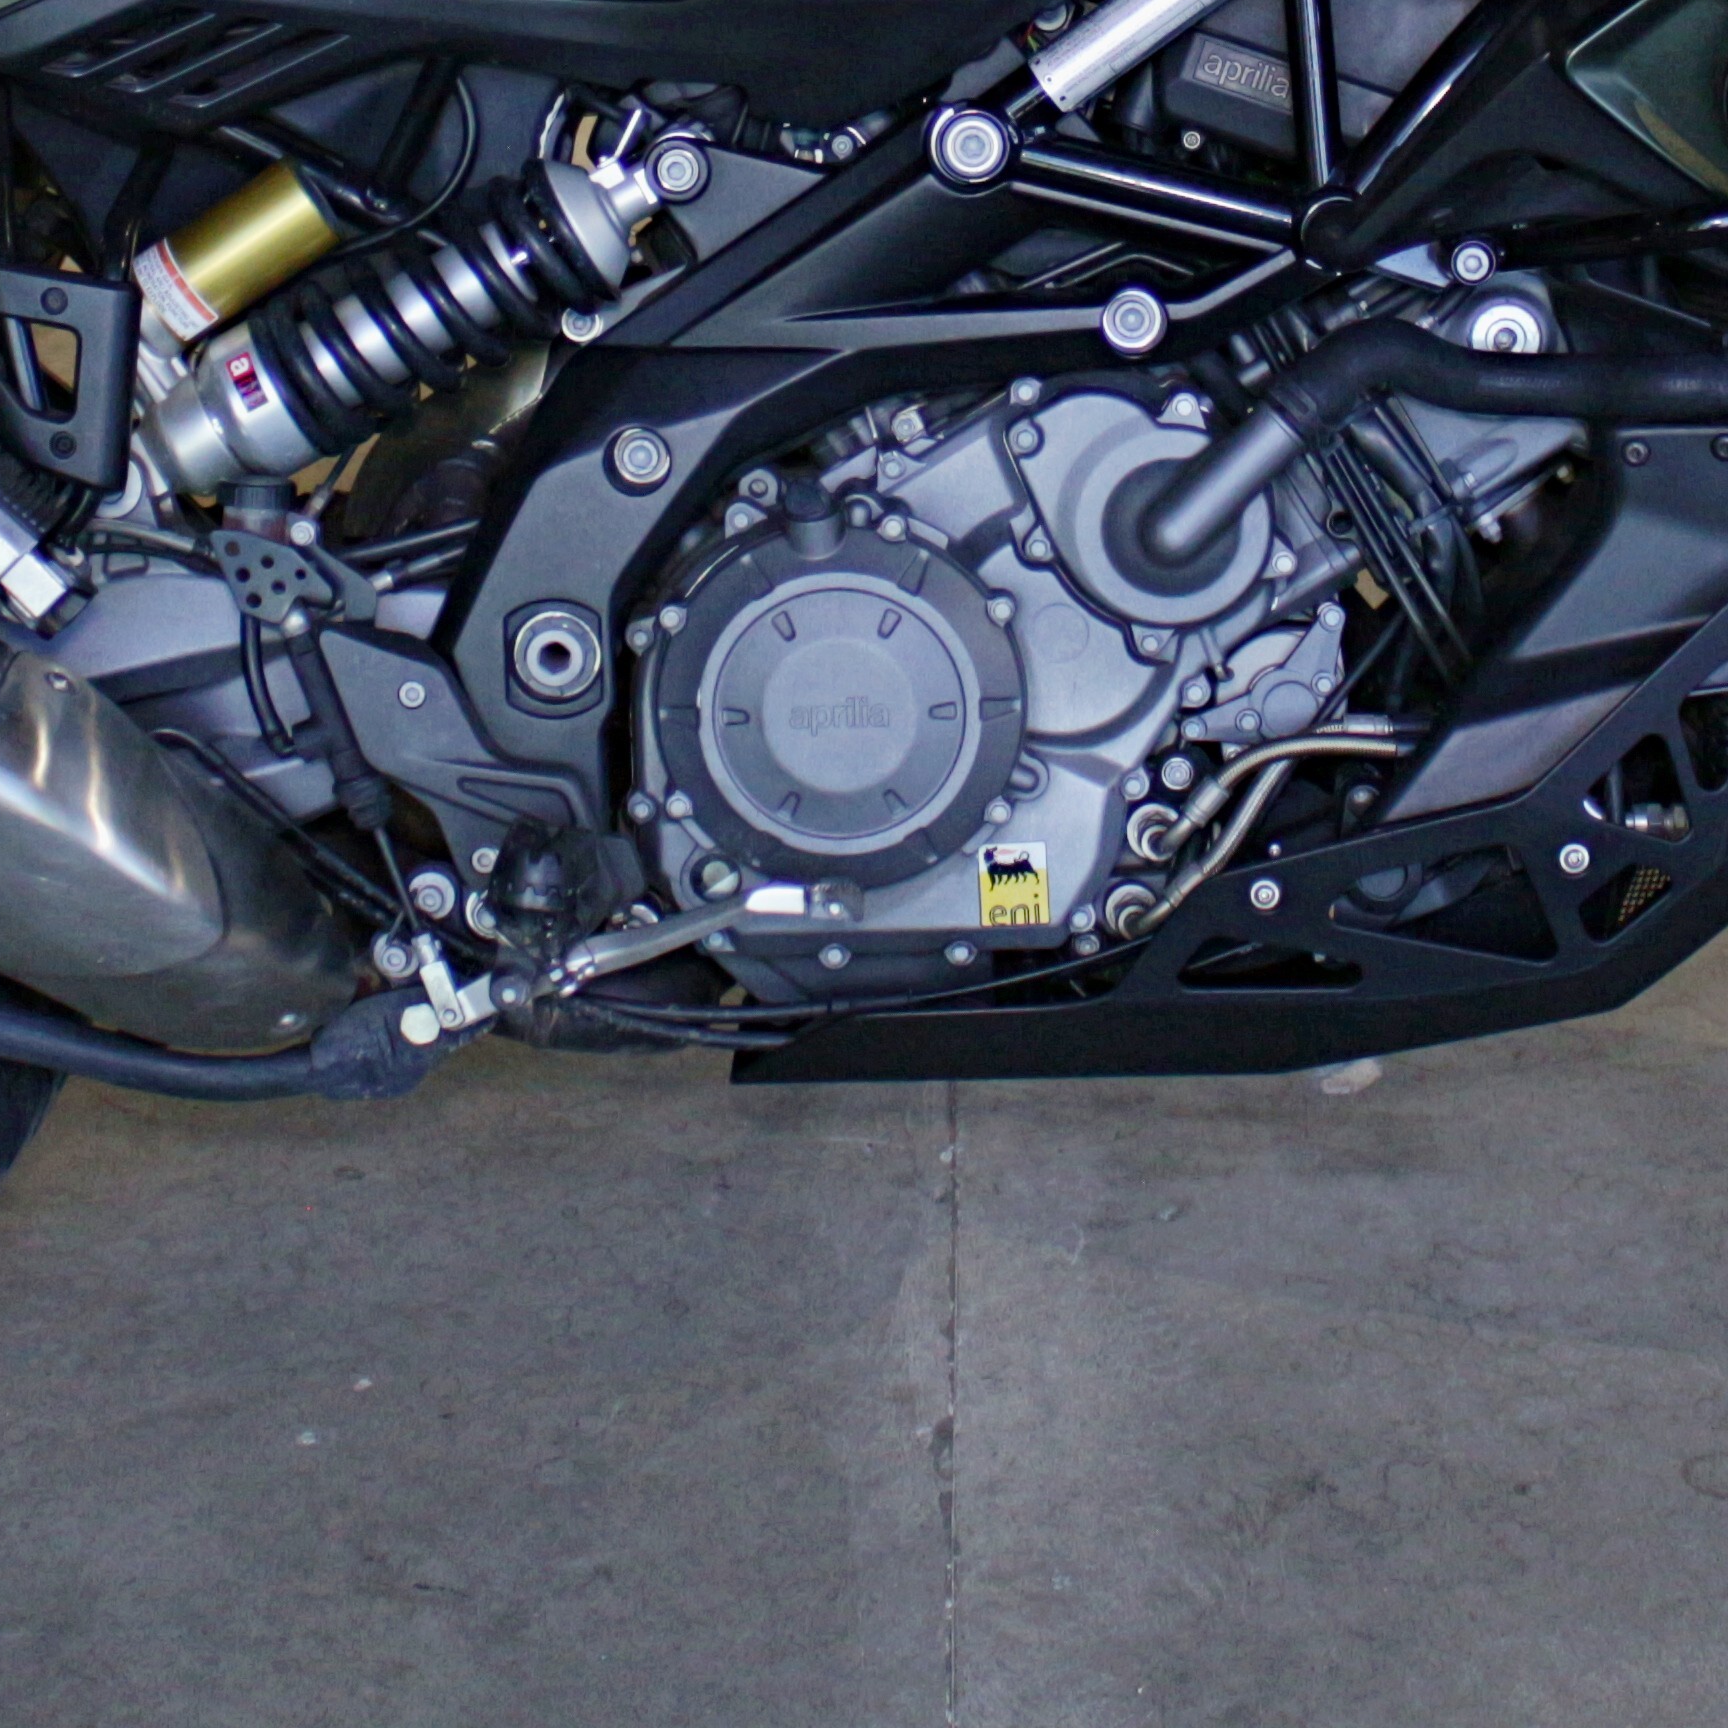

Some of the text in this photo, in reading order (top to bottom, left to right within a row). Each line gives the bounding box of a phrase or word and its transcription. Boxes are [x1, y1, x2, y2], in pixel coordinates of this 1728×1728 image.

[1203, 54, 1290, 99] aprilia
[789, 695, 890, 737] aprilia
[988, 893, 1041, 925] eni
